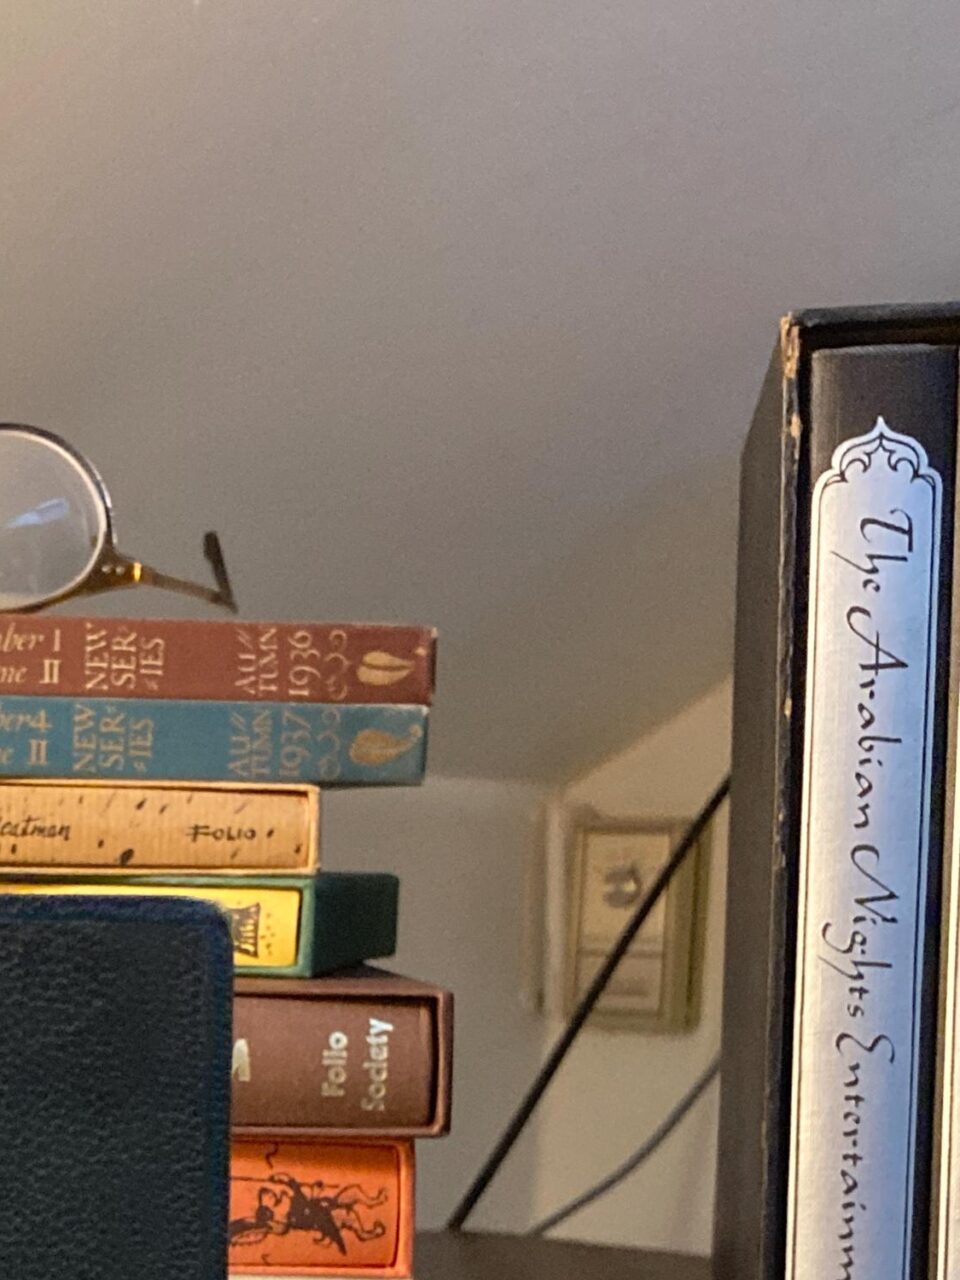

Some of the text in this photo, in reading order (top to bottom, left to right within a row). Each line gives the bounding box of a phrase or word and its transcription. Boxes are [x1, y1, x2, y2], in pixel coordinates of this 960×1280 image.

[831, 508, 914, 593] The
[84, 622, 109, 690] NEW
[288, 629, 321, 697] 1936
[72, 703, 97, 772] NEW
[279, 708, 312, 777] 1937
[846, 605, 909, 829] Arabian
[816, 844, 899, 1018] Nights
[321, 1031, 349, 1098] Folio
[360, 1018, 395, 1111] Society
